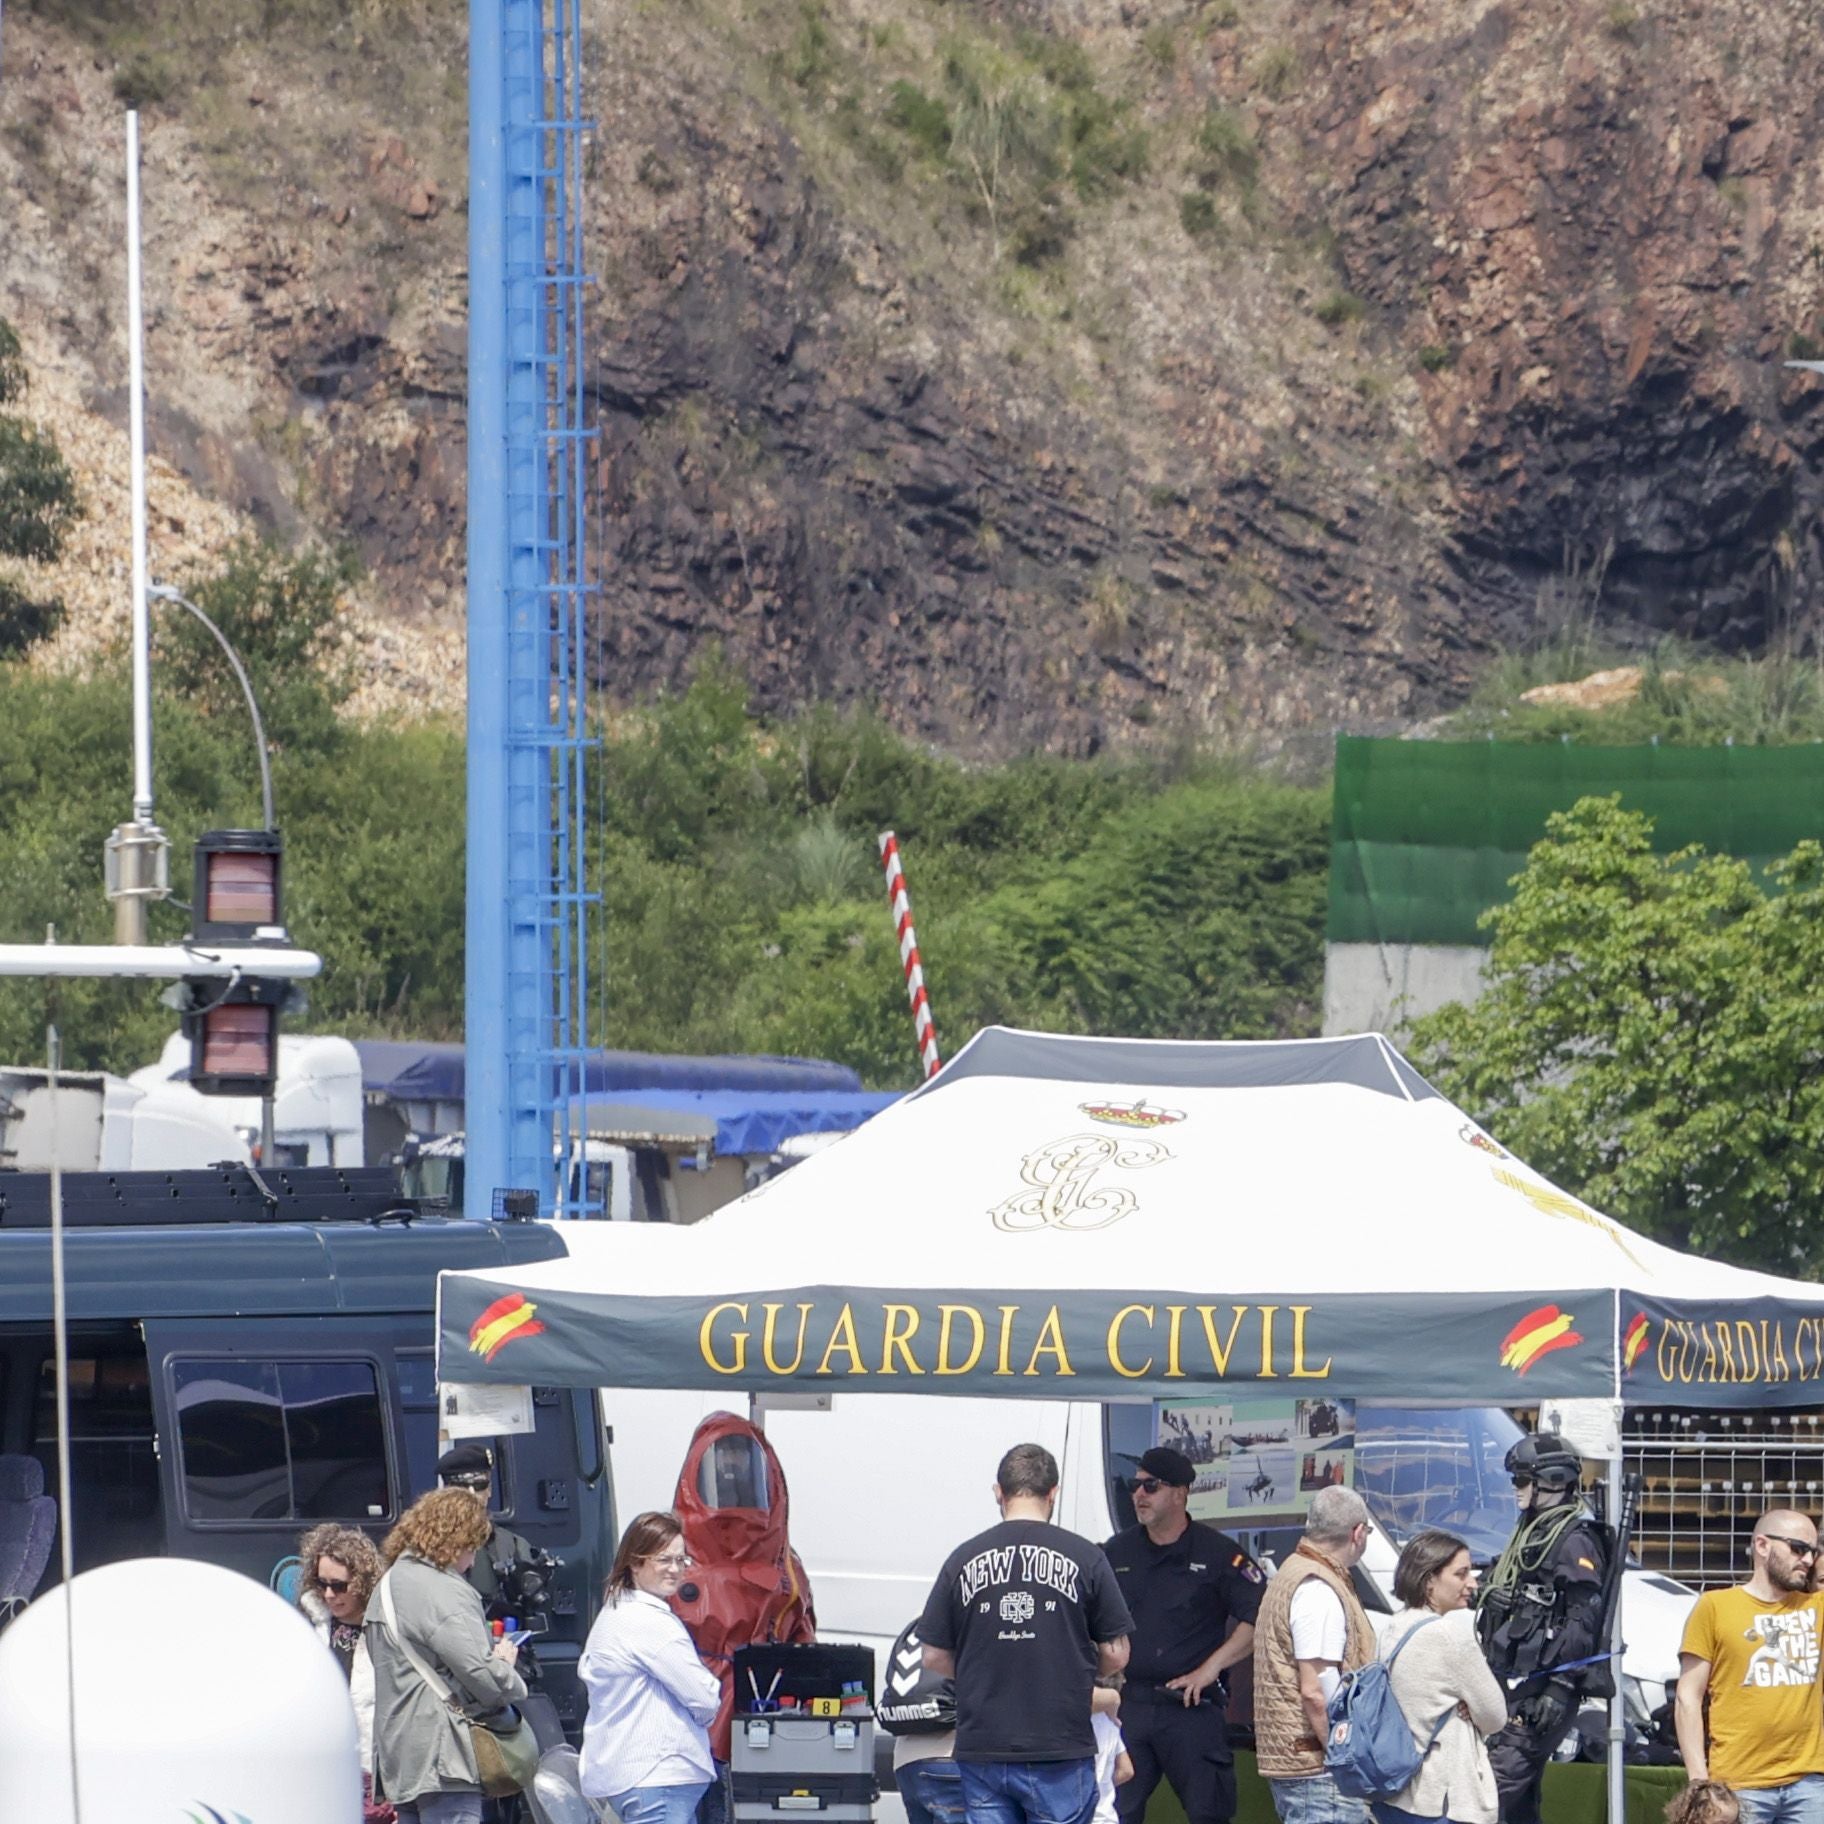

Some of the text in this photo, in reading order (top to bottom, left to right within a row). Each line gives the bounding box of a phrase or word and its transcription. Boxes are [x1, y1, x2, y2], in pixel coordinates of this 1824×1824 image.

[699, 1302, 1333, 1379] GUARDIA CIVIL
[1656, 1318, 1790, 1384] GUARDIA
[960, 1544, 1080, 1607] NEW YORK
[980, 1600, 1057, 1614] 19 91
[1779, 1631, 1820, 1662] THE
[822, 1700, 831, 1715] 8
[876, 1697, 942, 1722] hummel
